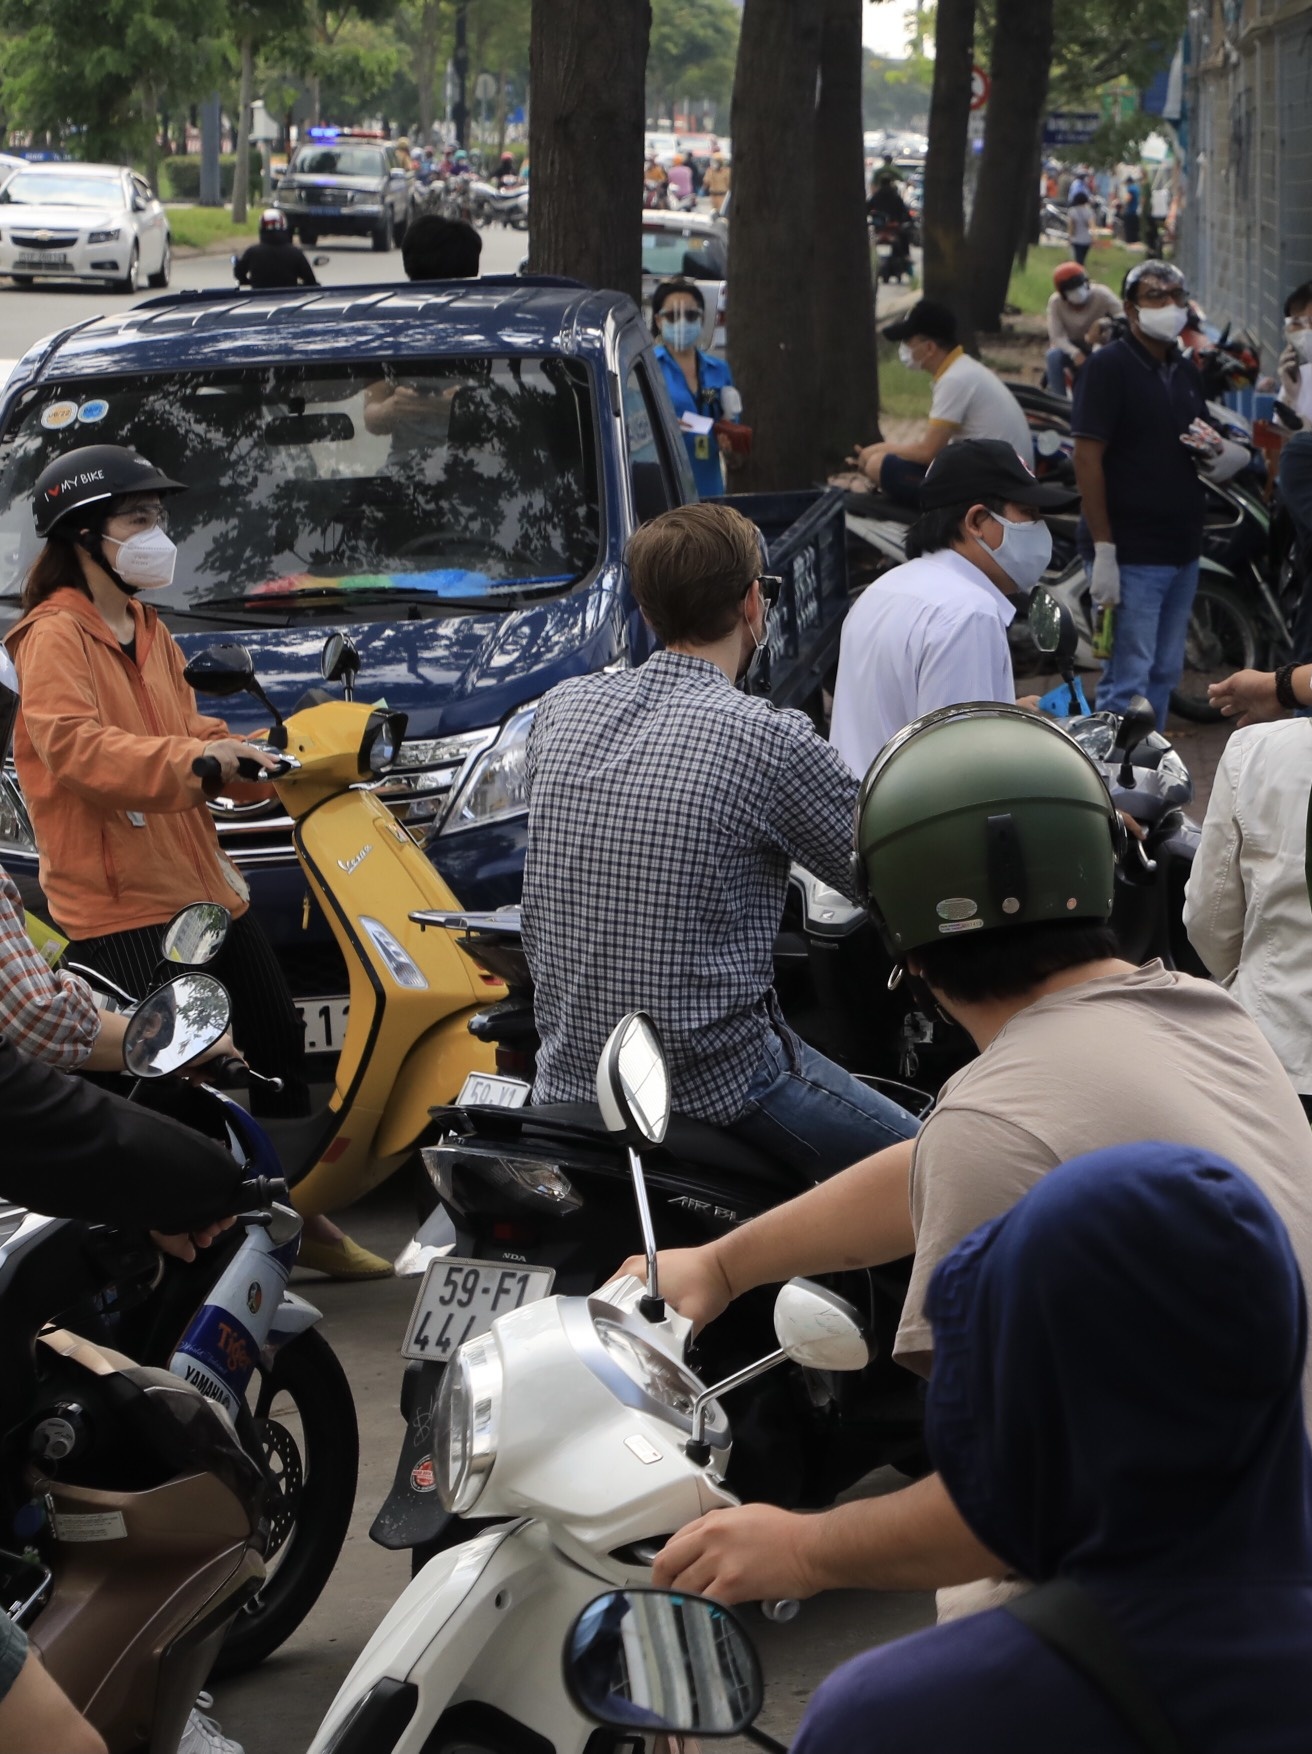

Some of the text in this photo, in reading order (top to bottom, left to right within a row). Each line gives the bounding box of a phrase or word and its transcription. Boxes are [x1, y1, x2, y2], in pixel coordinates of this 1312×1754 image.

[44, 469, 105, 503] I MY BIKE
[337, 844, 373, 875] Vespa
[667, 1195, 712, 1214] AIR
[438, 1266, 531, 1311] 59-F1
[184, 1365, 225, 1404] YAMAHA
